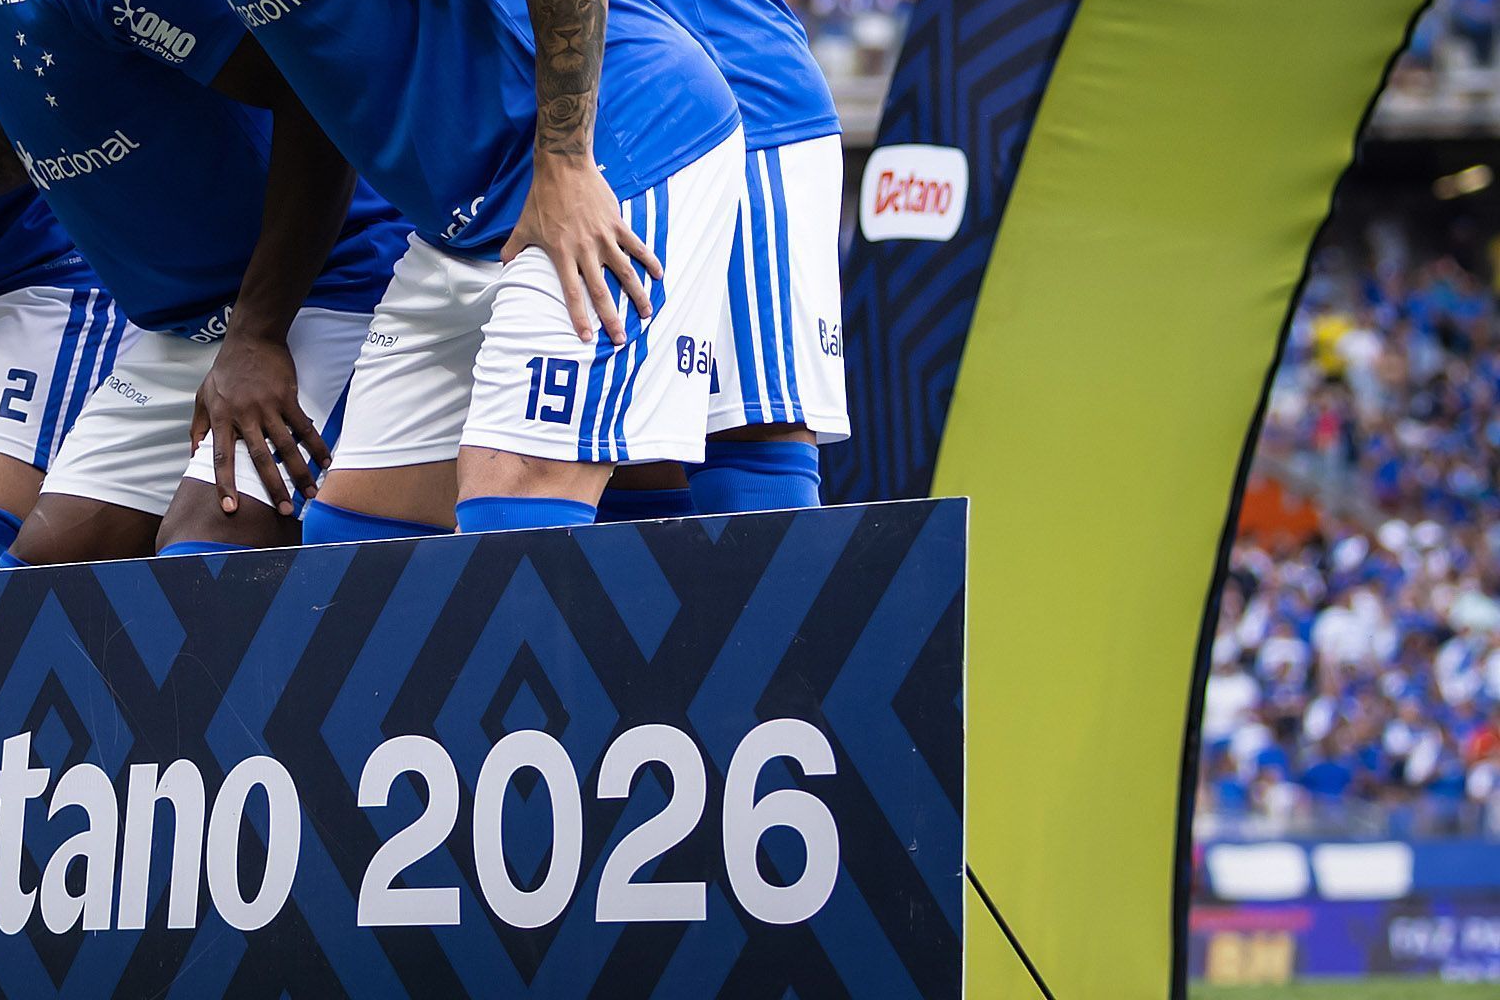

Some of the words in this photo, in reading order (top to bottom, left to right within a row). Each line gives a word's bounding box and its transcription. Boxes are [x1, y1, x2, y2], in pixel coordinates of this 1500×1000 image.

[135, 12, 197, 58] OMO
[36, 130, 141, 181] nacional
[875, 170, 953, 216] Betano
[525, 356, 580, 425] 19
[357, 718, 841, 929] 2026
